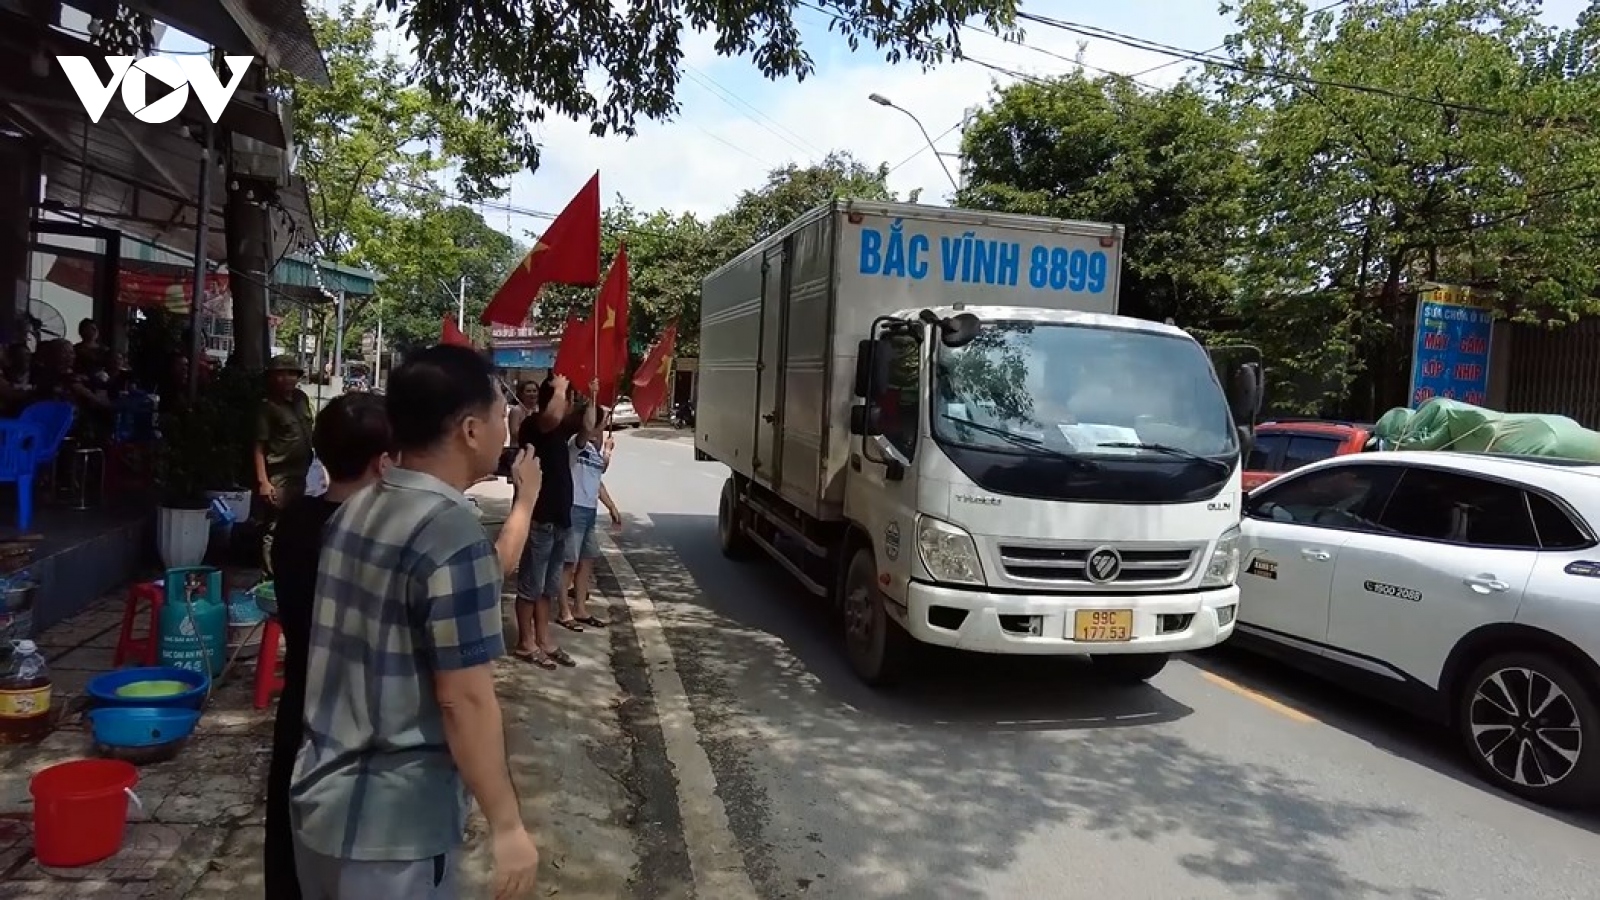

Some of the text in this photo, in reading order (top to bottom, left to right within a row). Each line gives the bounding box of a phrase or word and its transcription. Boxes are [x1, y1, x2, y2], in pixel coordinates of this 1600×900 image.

[859, 217, 1108, 294] BẮC VĨNH 8899
[1092, 611, 1117, 625] 99C
[1083, 626, 1126, 640] 177.53
